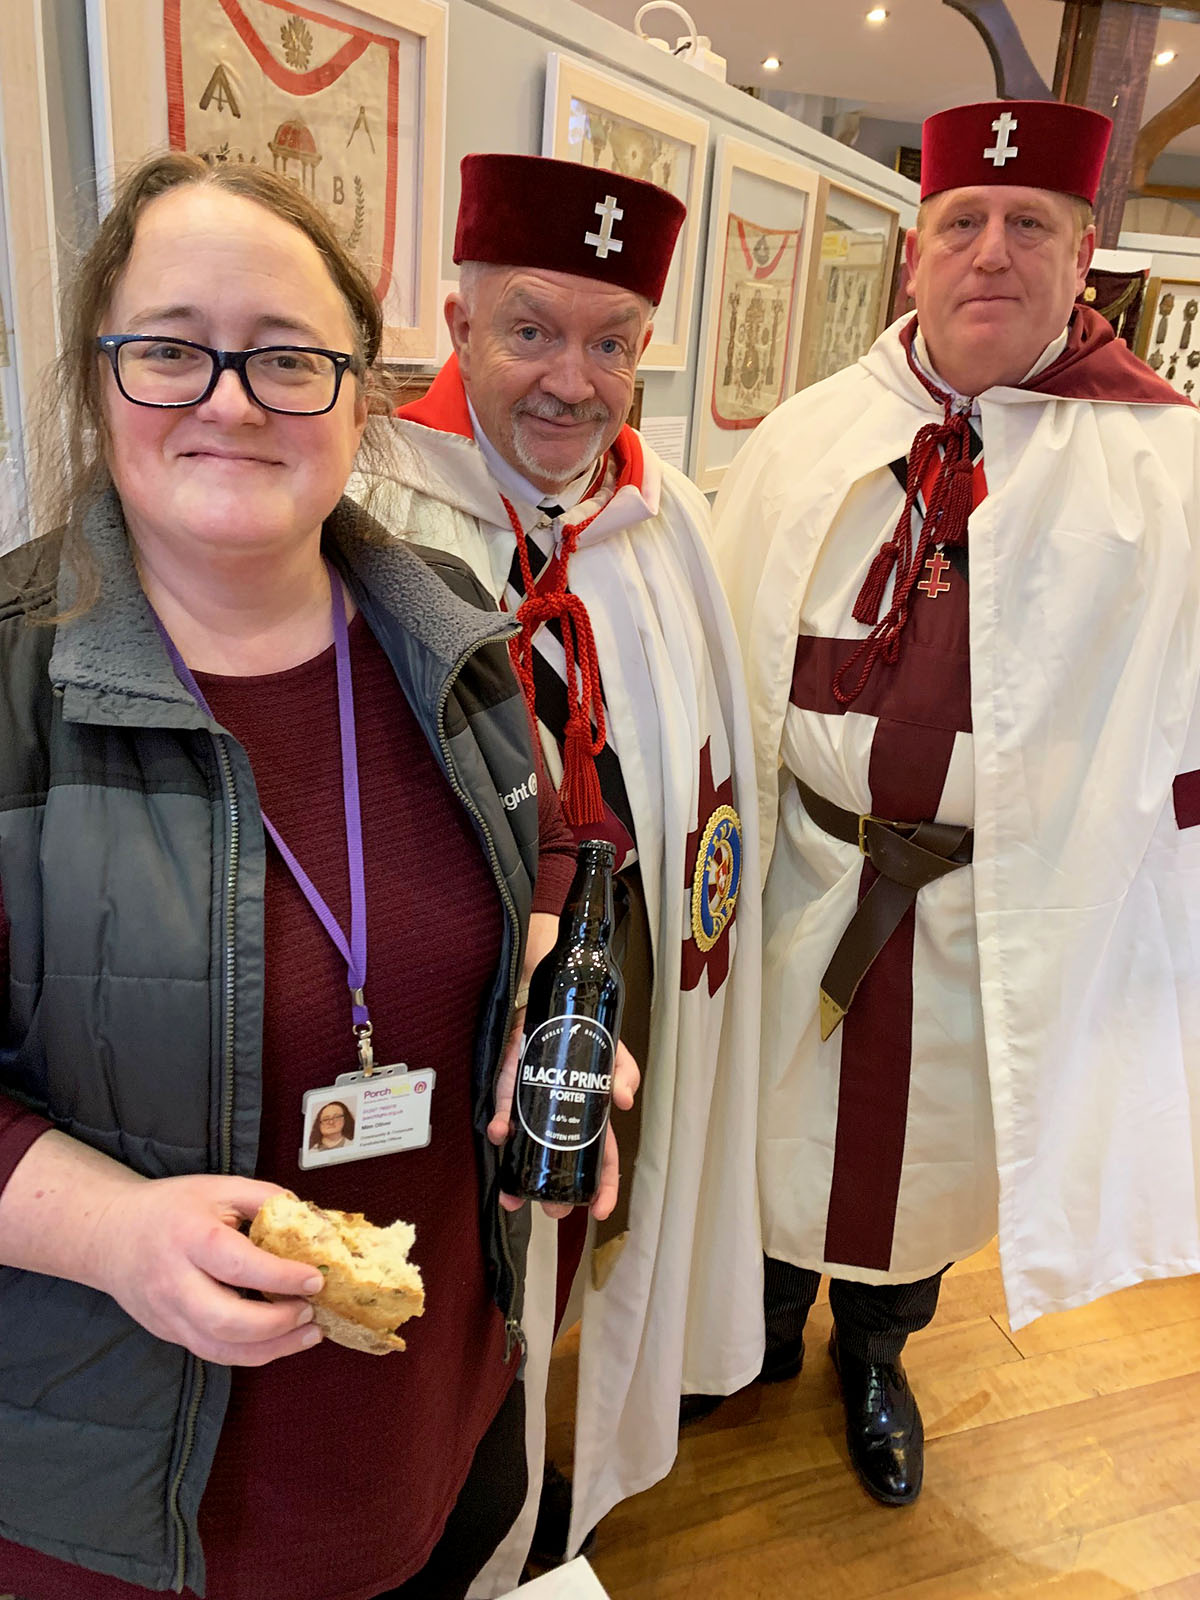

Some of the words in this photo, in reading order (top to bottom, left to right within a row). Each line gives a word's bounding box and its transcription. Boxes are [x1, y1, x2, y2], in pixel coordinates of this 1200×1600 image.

[332, 176, 345, 204] B
[522, 1064, 567, 1086] BLACK
[569, 1070, 611, 1090] PRINCE
[549, 1089, 586, 1103] PORTER
[545, 1130, 567, 1141] GLUTEN
